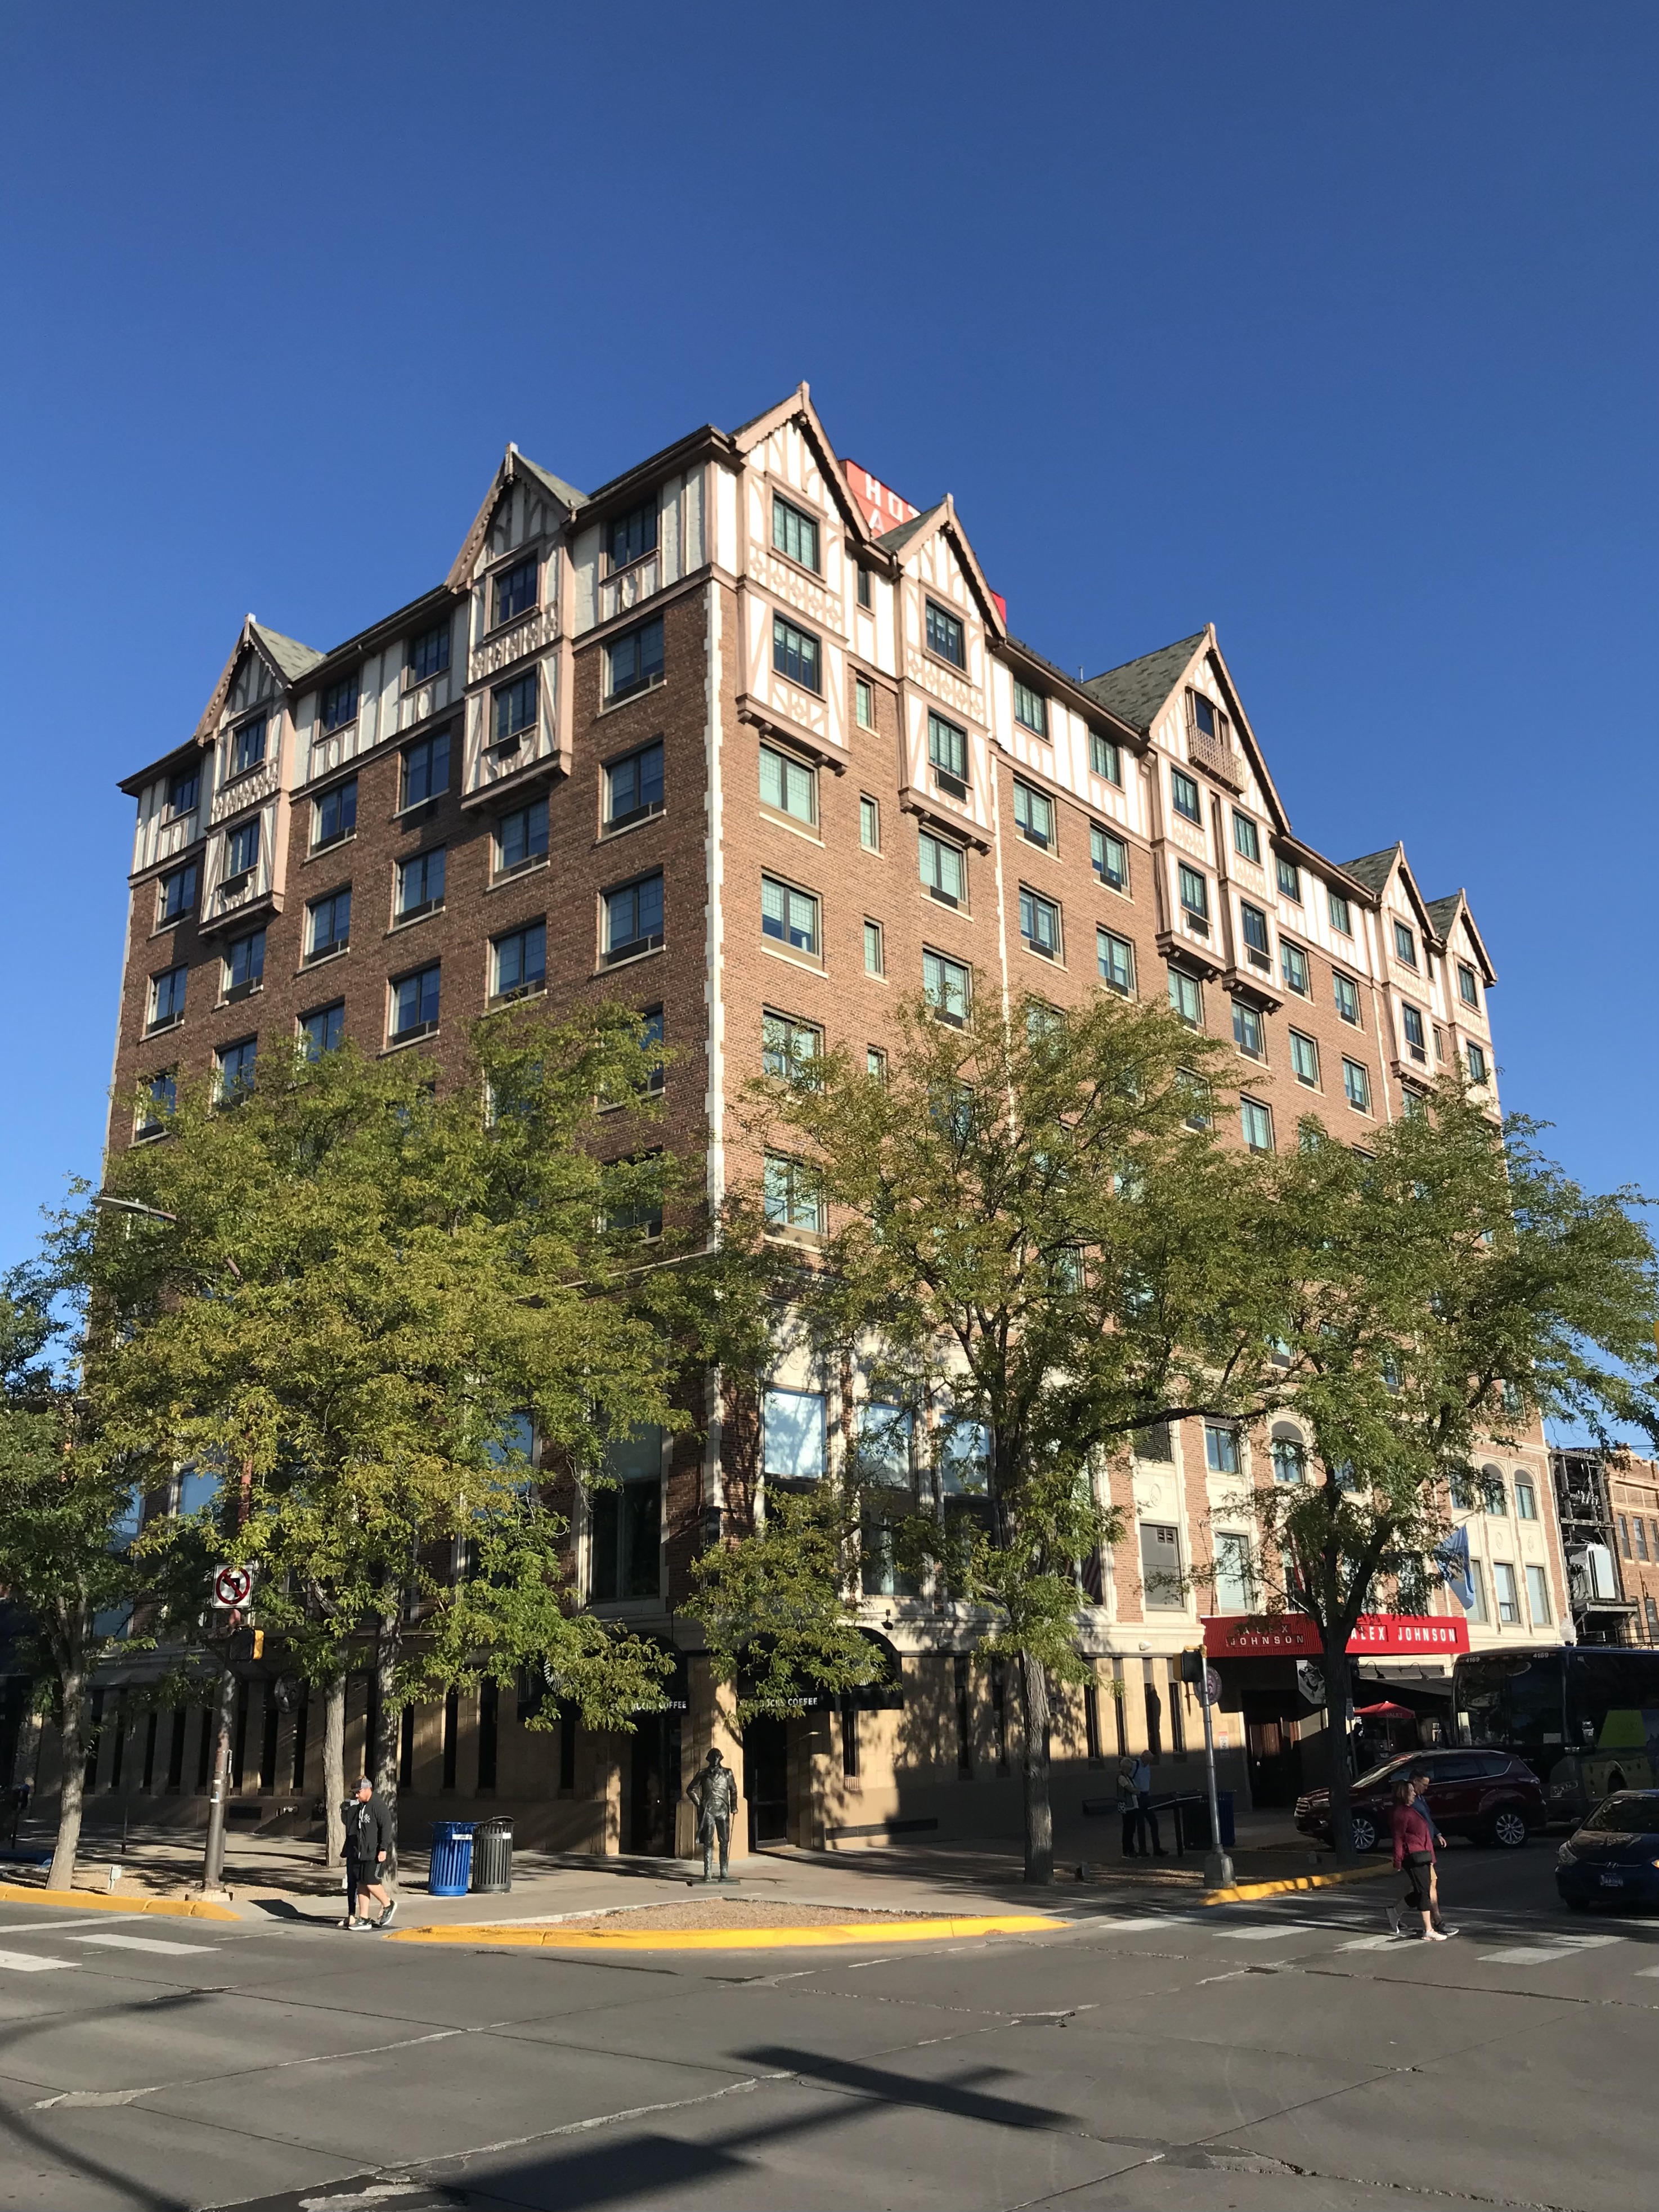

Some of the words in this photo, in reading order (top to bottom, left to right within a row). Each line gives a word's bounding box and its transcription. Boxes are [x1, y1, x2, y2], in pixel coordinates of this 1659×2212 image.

[1351, 1626, 1385, 1640] ALEX
[1398, 1627, 1456, 1642] JOHNSON
[1231, 1635, 1304, 1645] JOHNSON
[788, 1697, 818, 1706] COFFEE
